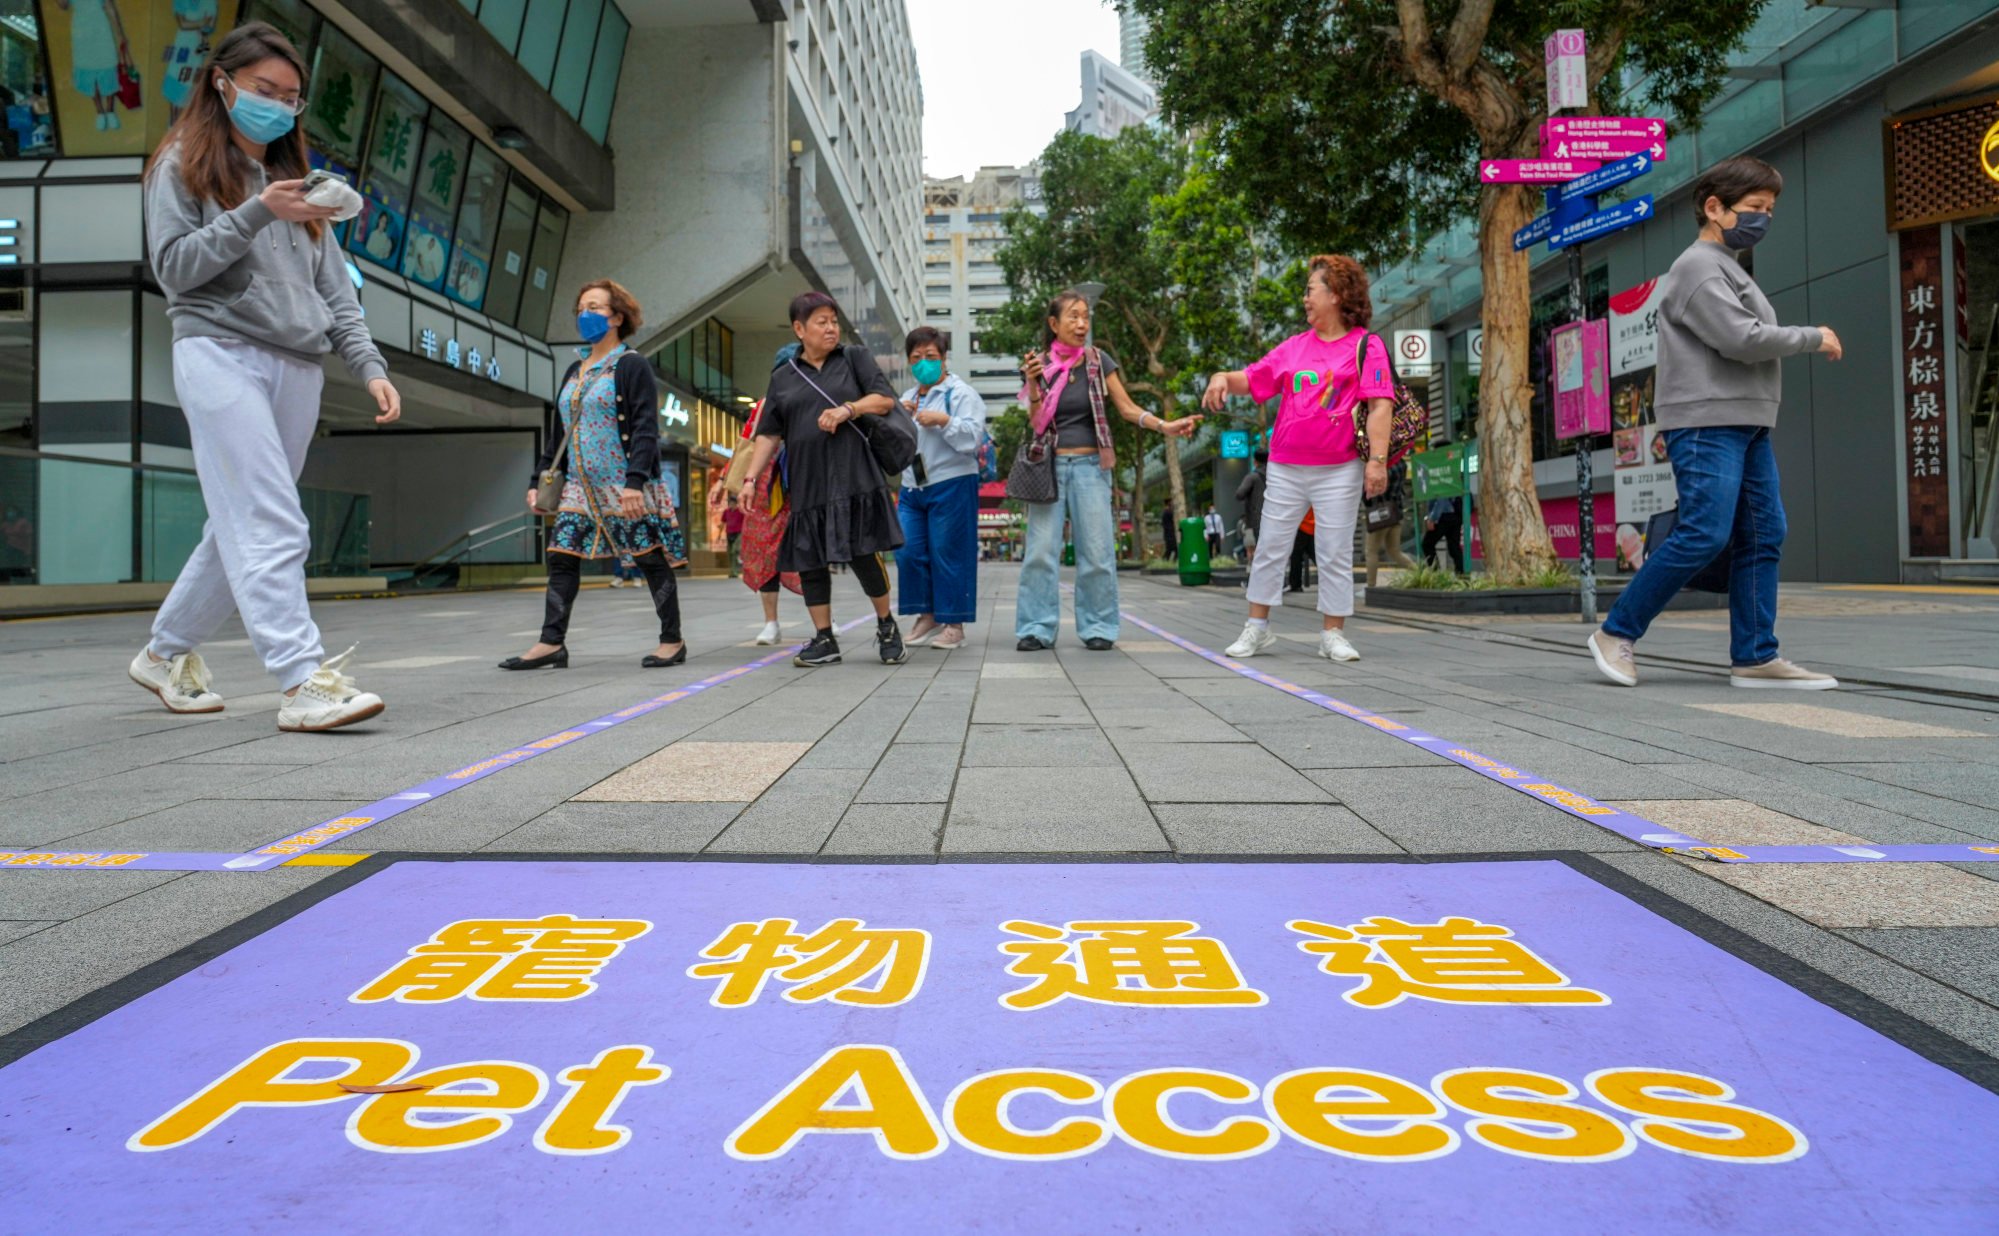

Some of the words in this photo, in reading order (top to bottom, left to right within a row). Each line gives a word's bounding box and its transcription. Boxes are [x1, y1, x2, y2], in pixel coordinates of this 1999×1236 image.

[1519, 171, 1534, 179] Tsim
[420, 328, 501, 381] 半島中心
[1907, 284, 1940, 420] 東方棕泉
[1912, 425, 1926, 477] サウナスパ
[1548, 524, 1576, 538] CHINA
[350, 914, 1610, 1011] 寵物通道
[128, 1037, 671, 1154] Pet
[724, 1044, 1810, 1163] Access
